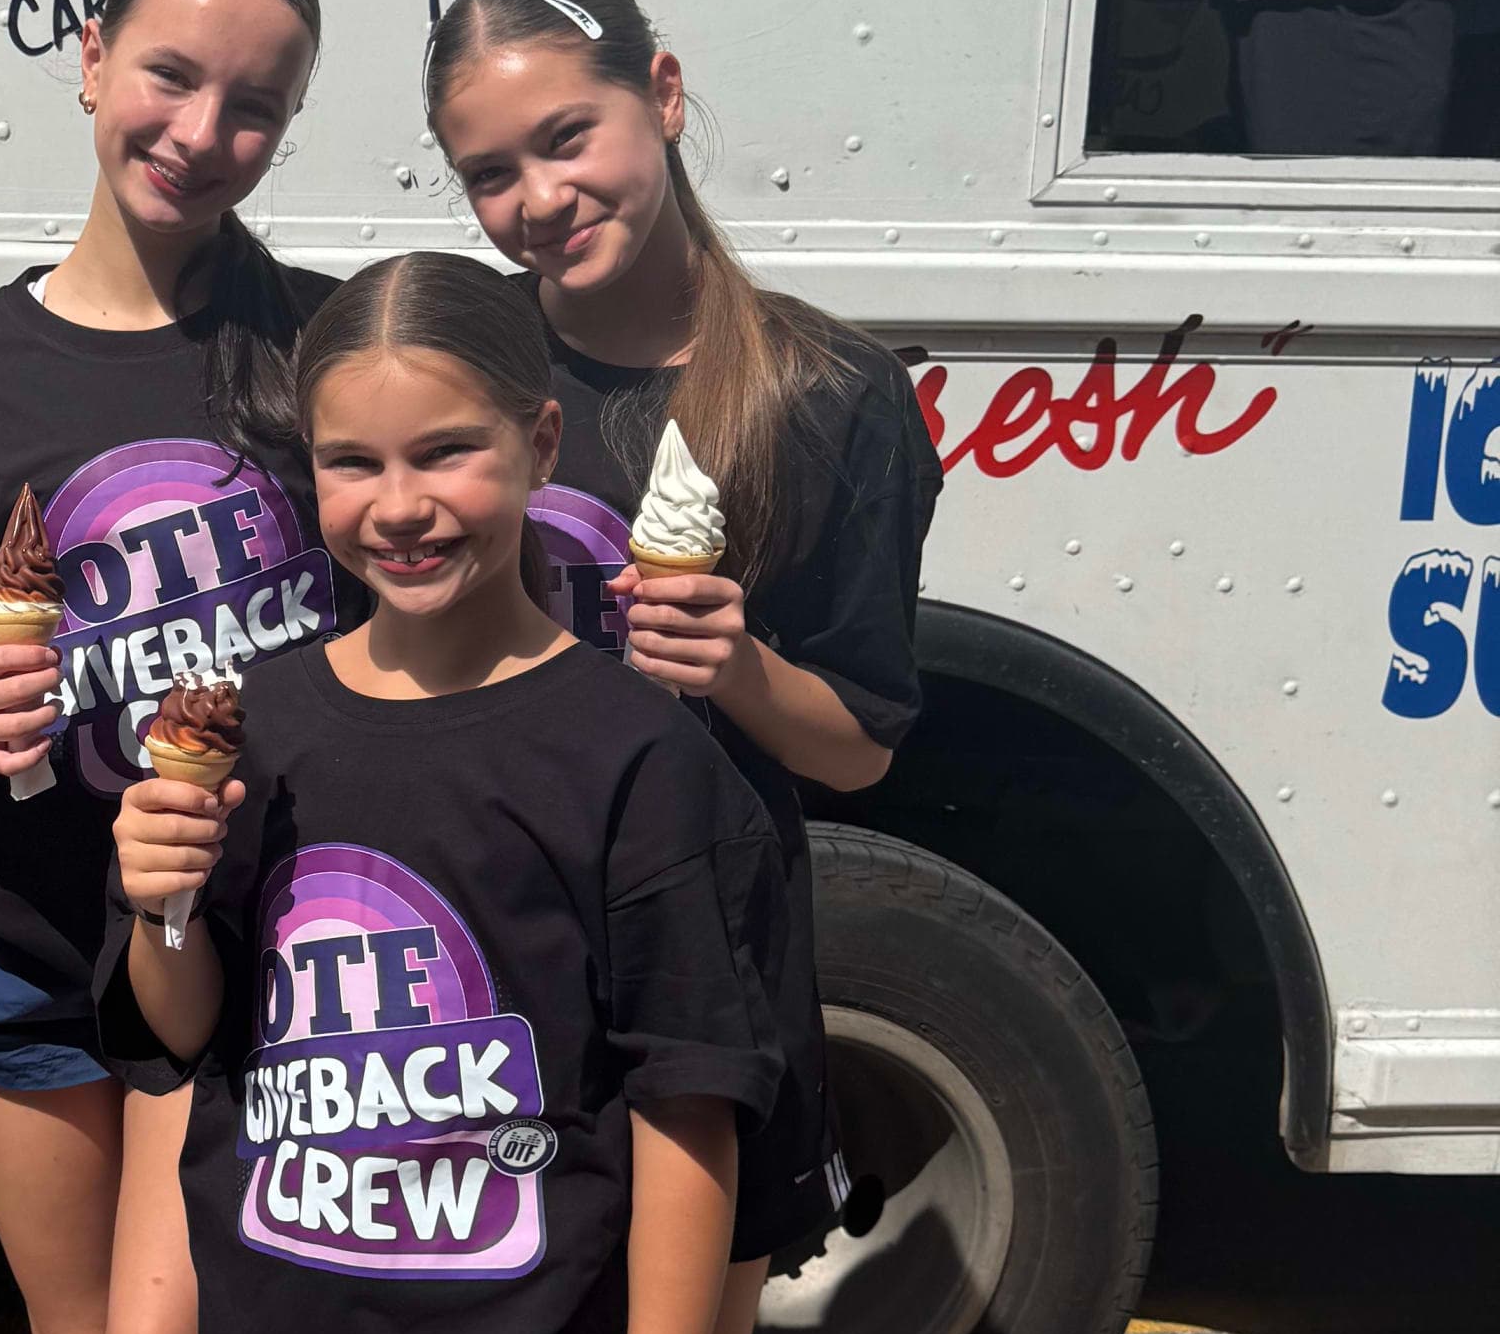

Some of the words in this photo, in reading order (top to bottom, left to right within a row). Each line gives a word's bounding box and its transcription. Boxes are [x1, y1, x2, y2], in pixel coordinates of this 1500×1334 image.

[57, 489, 264, 622] OTF
[260, 926, 440, 1045] OTF
[245, 1039, 518, 1145] GIVEBACK
[266, 1140, 490, 1241] CREW
[503, 1141, 539, 1163] OTF
